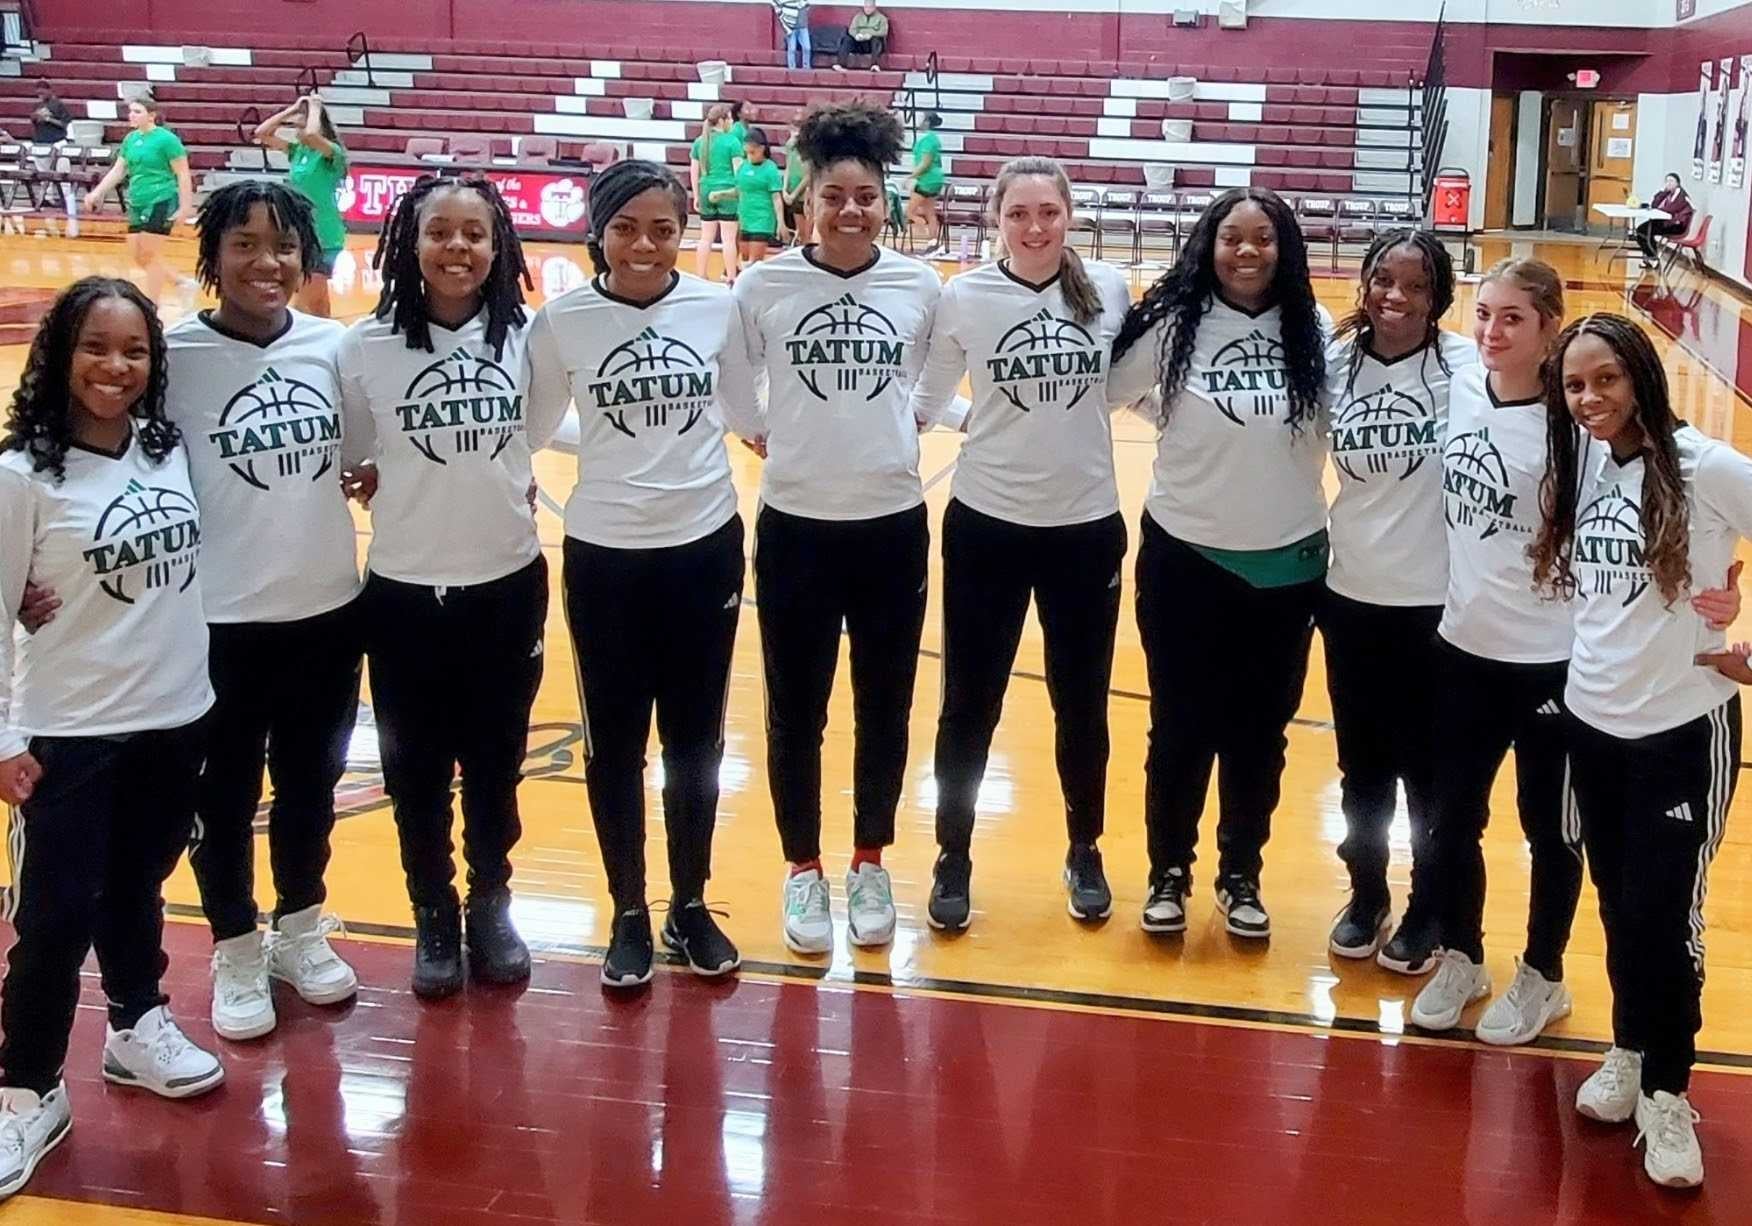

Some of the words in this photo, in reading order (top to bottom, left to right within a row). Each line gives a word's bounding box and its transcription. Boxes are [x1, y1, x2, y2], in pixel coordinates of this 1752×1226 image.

[786, 339, 904, 366] TATUM
[987, 350, 1102, 383] TATUM
[588, 372, 712, 408] TATUM
[1202, 369, 1286, 392] TATU
[396, 395, 523, 431] TATUM
[209, 414, 342, 459] TATUM
[1387, 447, 1446, 459] BASKETBA
[1443, 467, 1518, 519] ATUM
[1574, 535, 1650, 568] ATUM
[1613, 570, 1655, 582] BASKET
